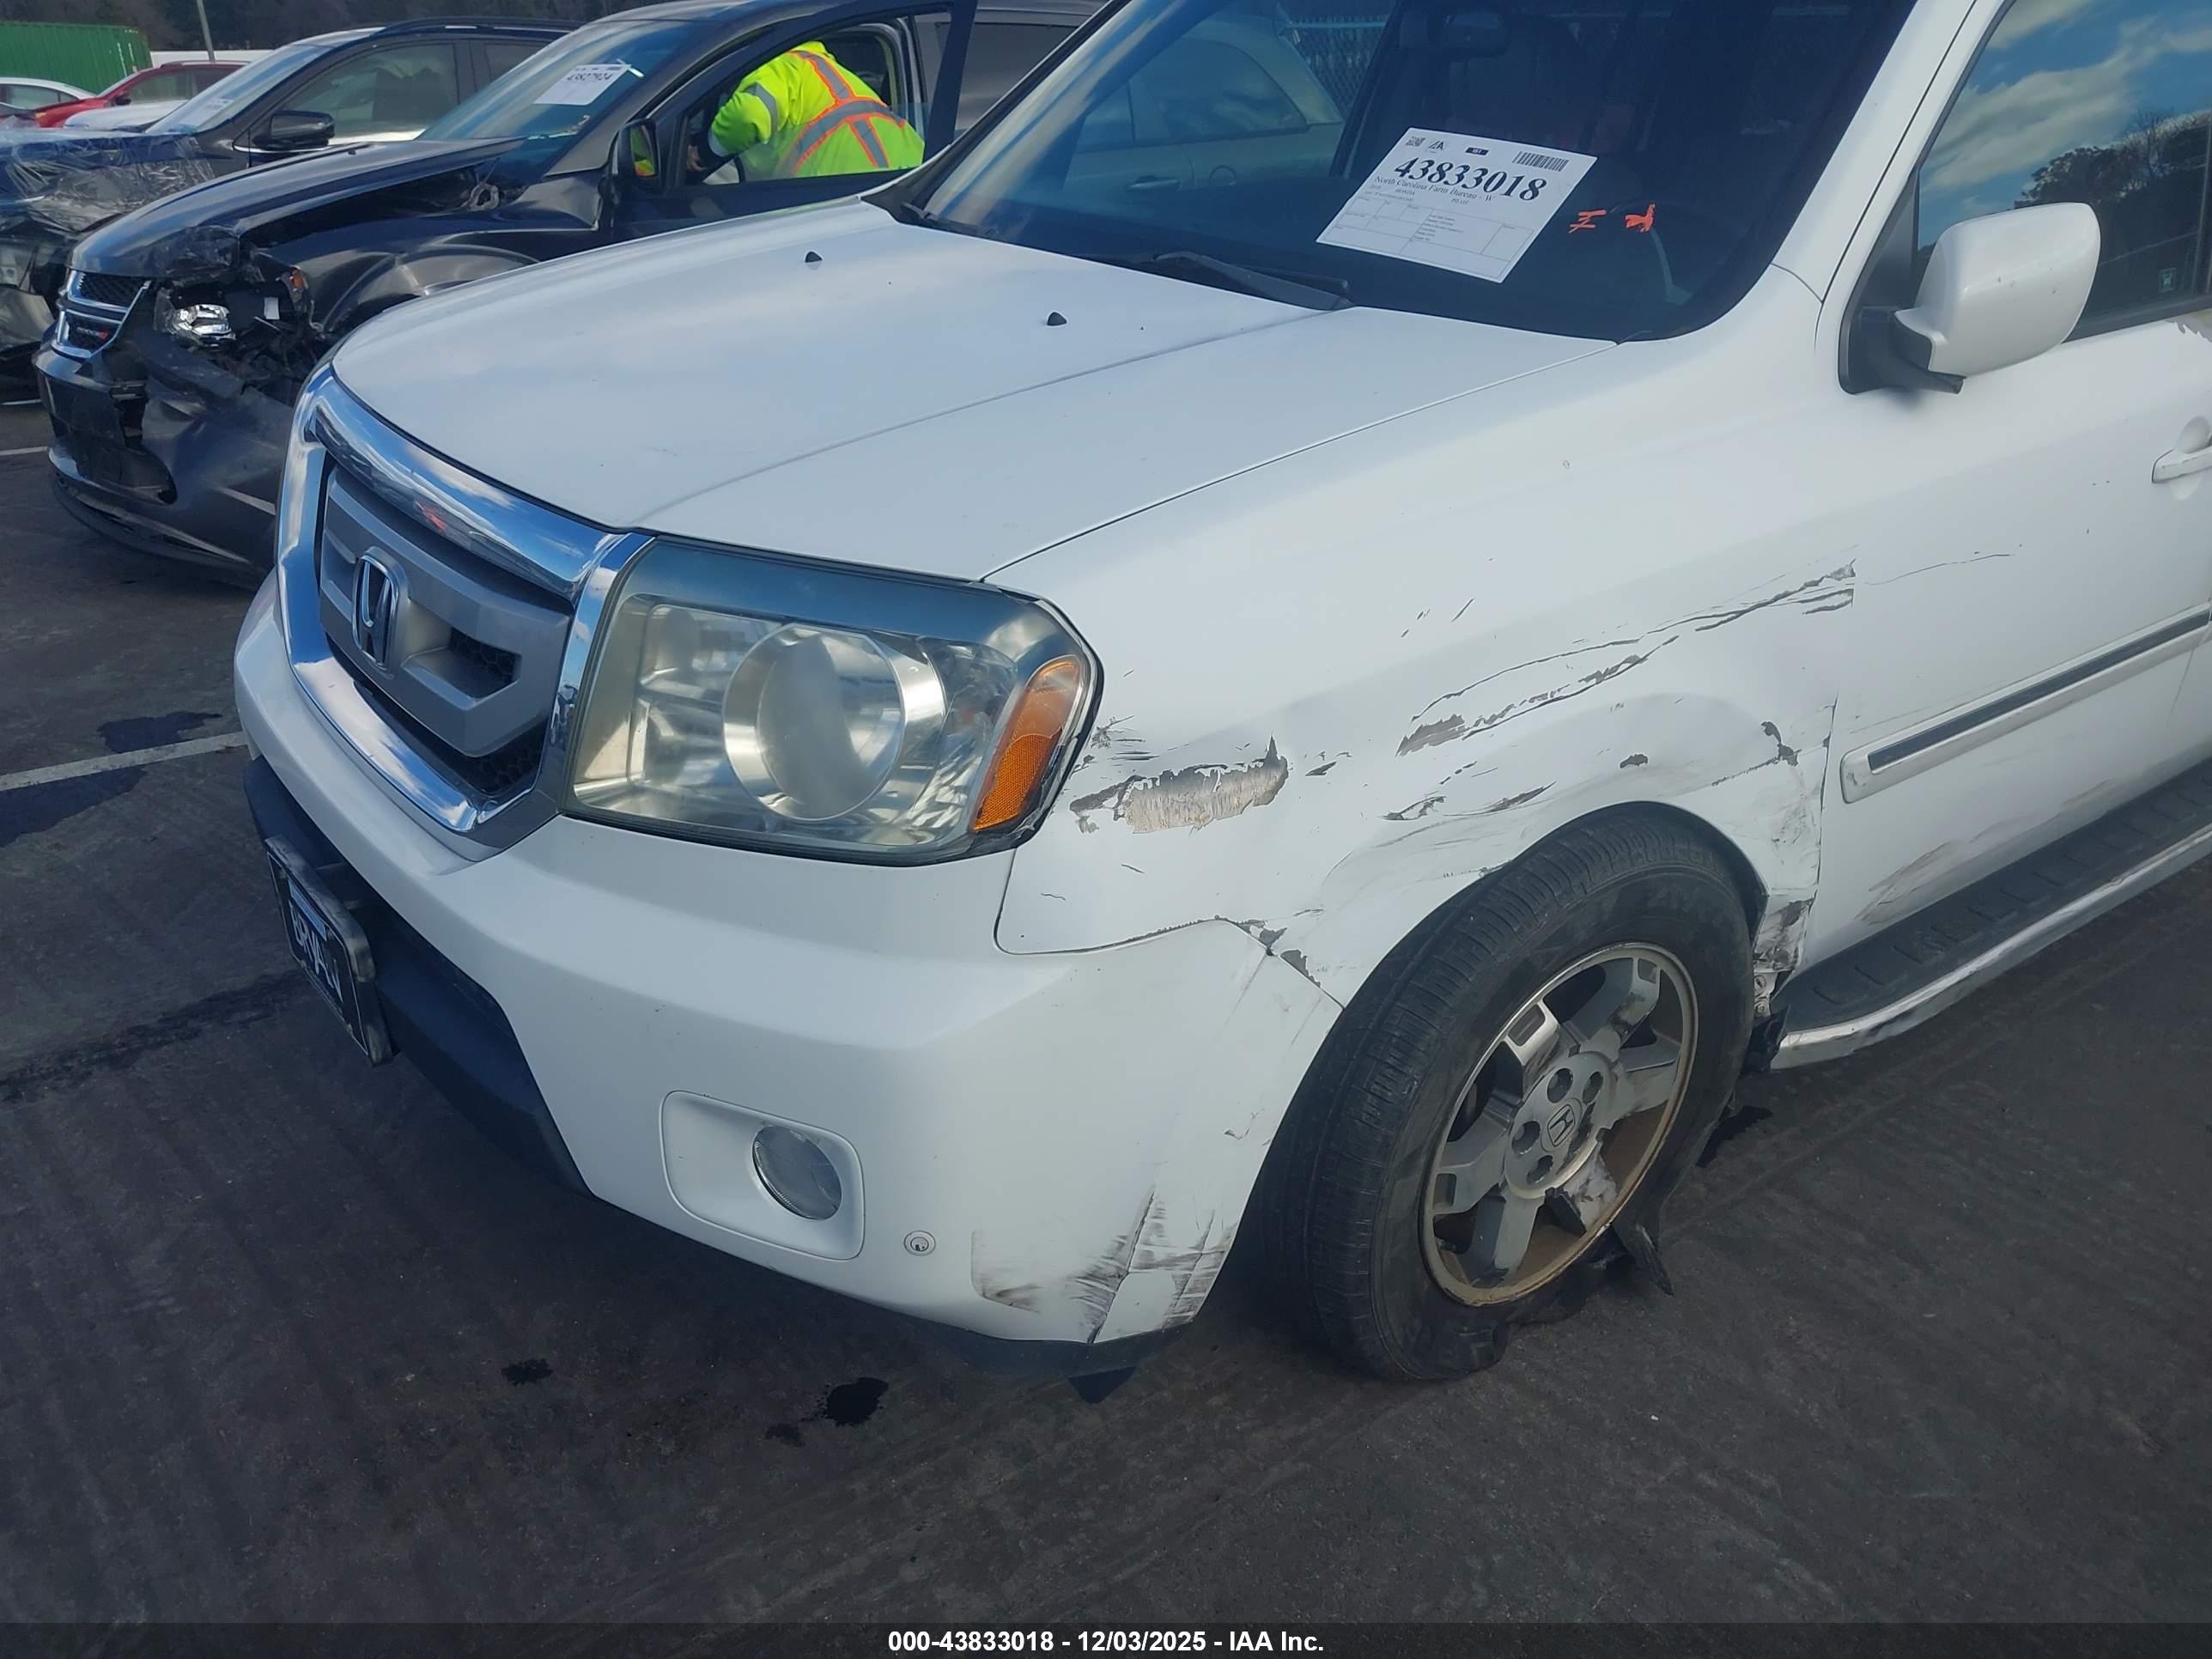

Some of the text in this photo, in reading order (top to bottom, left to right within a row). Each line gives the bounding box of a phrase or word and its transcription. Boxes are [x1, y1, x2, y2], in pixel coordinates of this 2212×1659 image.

[1375, 175, 1396, 185] North
[1396, 179, 1430, 191] Carolina
[1429, 185, 1449, 194] Farm
[1449, 188, 1478, 200] Bureau
[1485, 194, 1496, 203] W
[1394, 157, 1547, 201] 43833018
